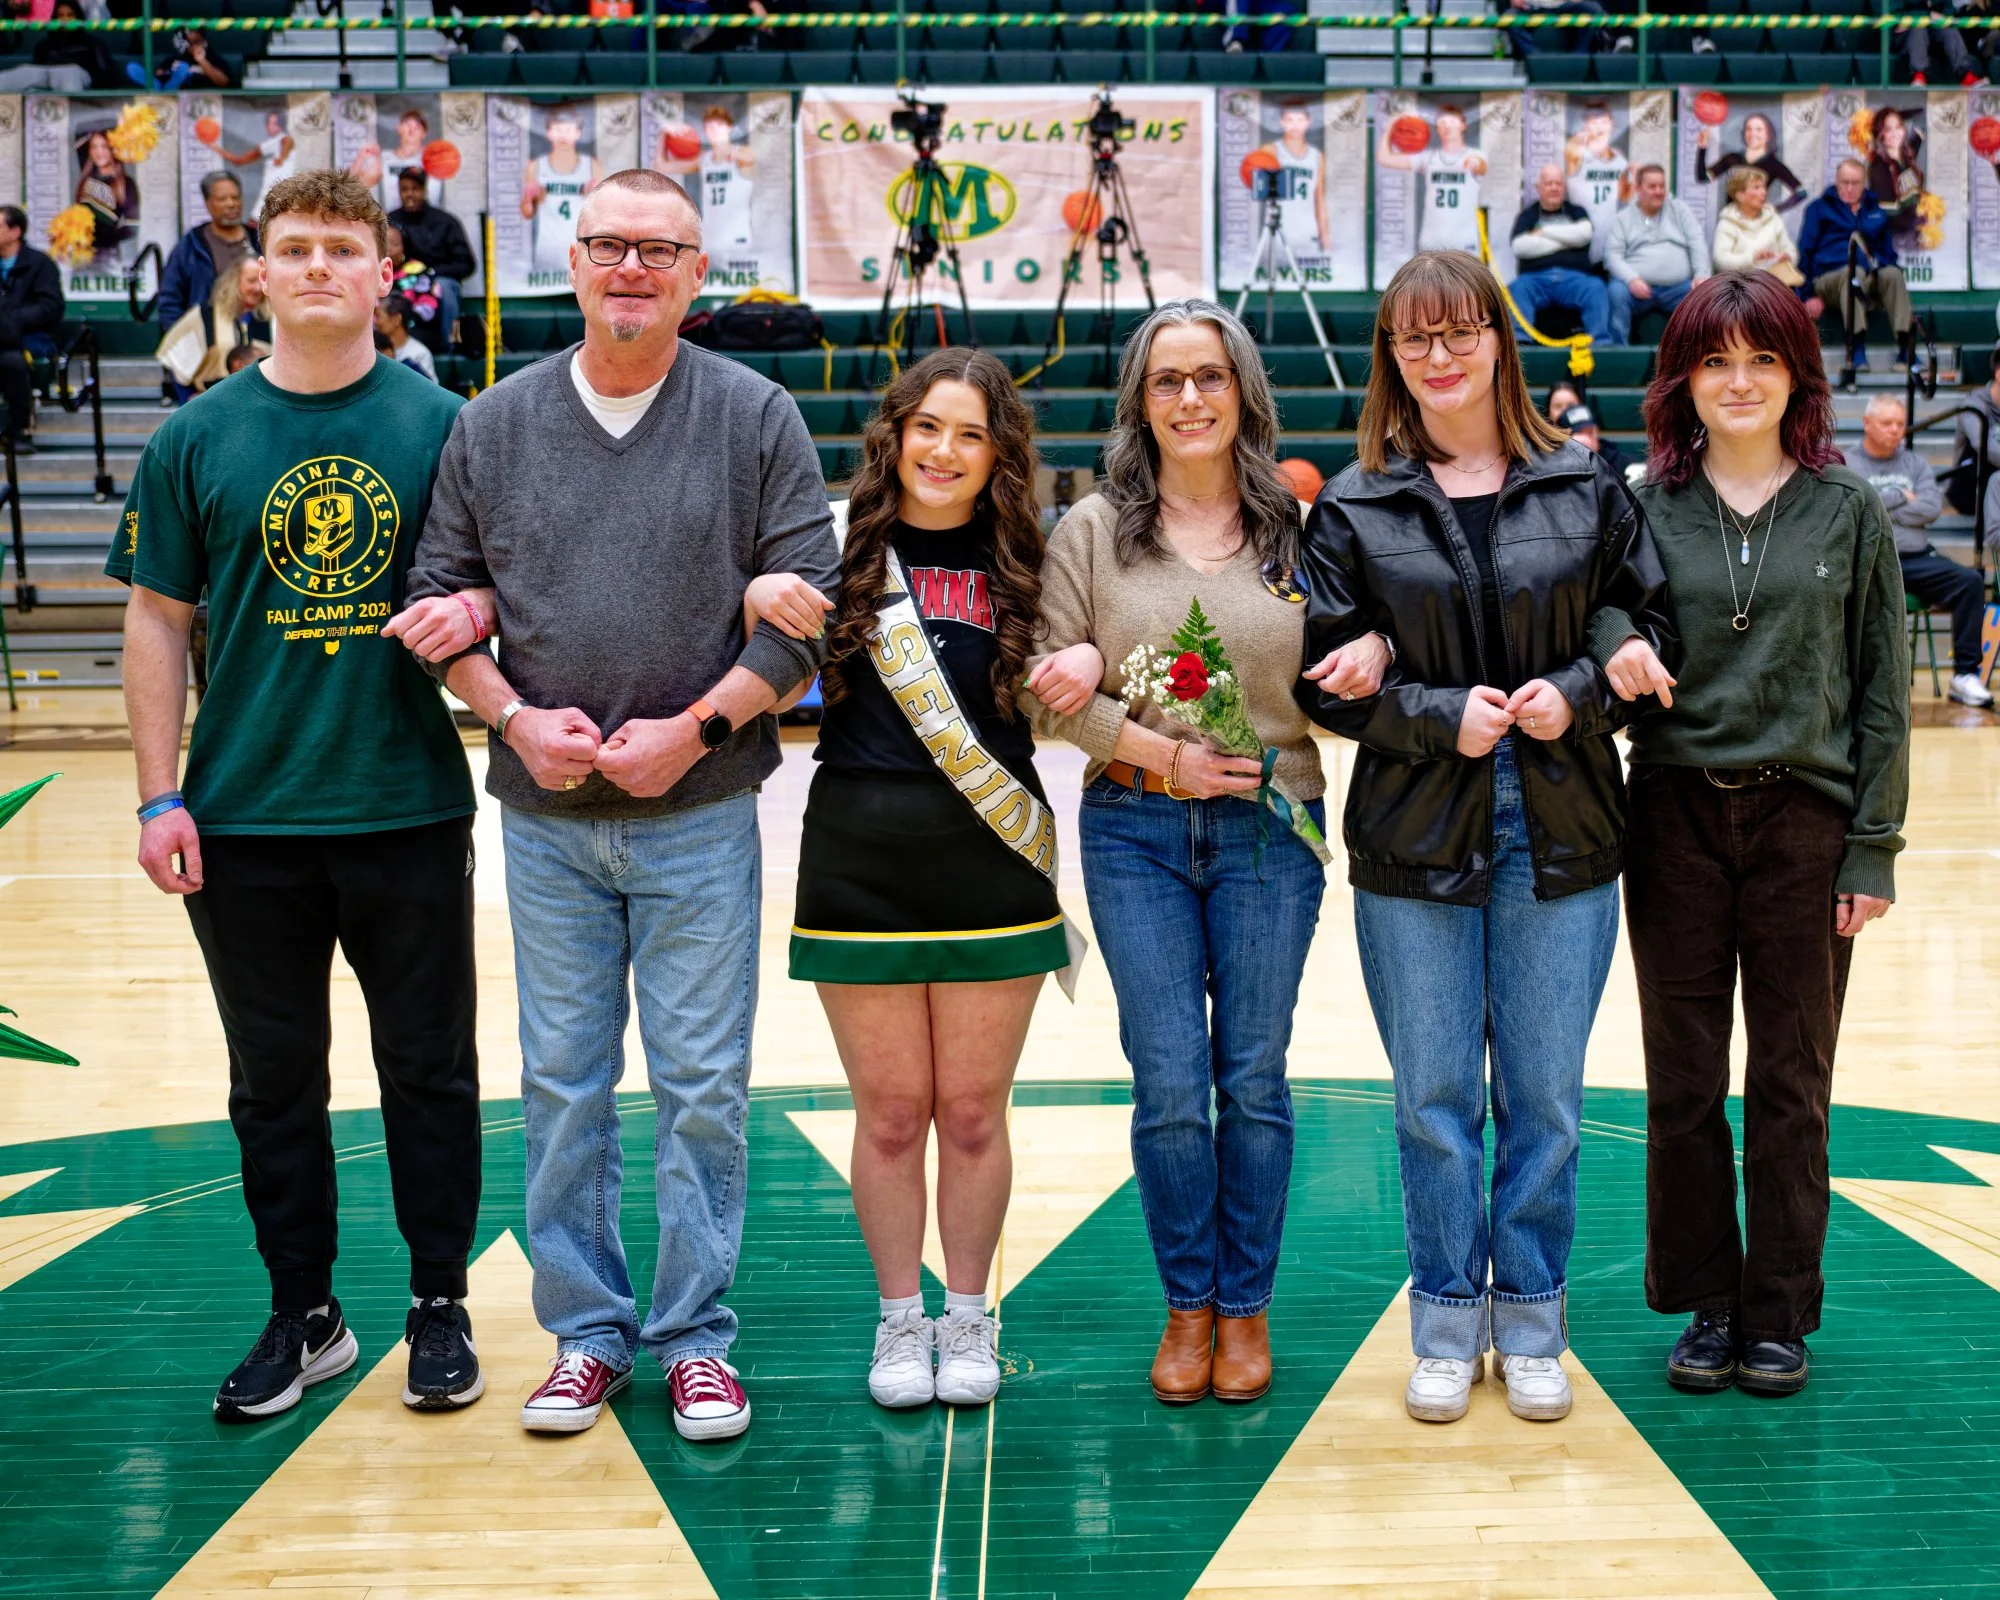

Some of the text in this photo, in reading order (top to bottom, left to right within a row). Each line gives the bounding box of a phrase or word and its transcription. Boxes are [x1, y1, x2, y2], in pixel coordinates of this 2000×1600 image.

[1435, 188, 1459, 208] 20
[497, 180, 521, 255] MEDINA
[558, 201, 571, 220] 4
[268, 462, 393, 531] MEDINA BEES
[307, 573, 355, 592] RFC
[267, 609, 299, 624] FALL
[304, 604, 353, 622] CAMP
[284, 624, 378, 640] DEFEND THE HIVE!
